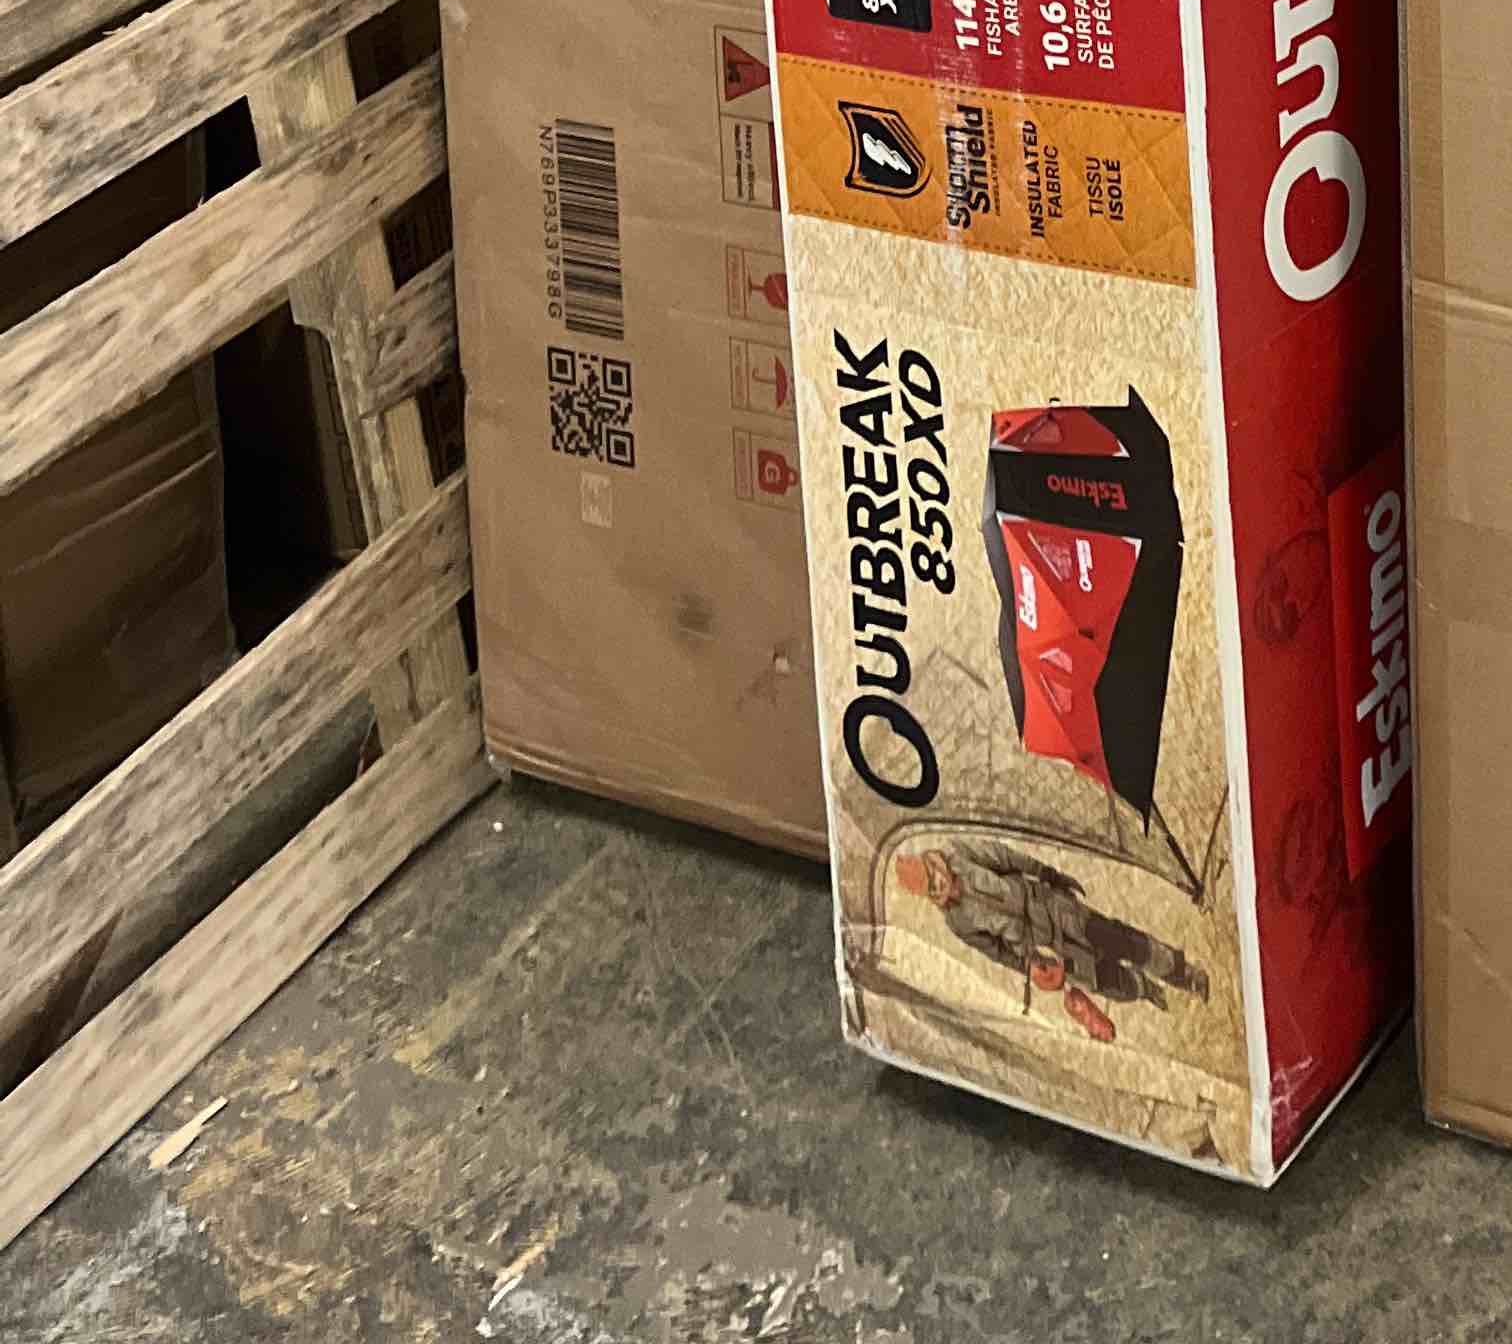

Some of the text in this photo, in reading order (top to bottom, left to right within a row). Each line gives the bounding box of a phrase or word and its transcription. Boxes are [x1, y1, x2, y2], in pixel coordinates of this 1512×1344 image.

[1041, 1, 1073, 70] 10,6
[1098, 42, 1115, 69] DE
[957, 104, 990, 214] Shield
[1023, 120, 1044, 239] INSULATED
[1043, 145, 1063, 219] FABRIC
[1086, 157, 1104, 217] TISSU
[1103, 159, 1123, 222] ISOLÉ
[538, 124, 563, 320] N769P333798G
[898, 349, 955, 595] 850XD
[1047, 475, 1127, 510] Eskimo
[833, 328, 940, 808] OUTBREAK
[1358, 490, 1413, 827] Eskimo
